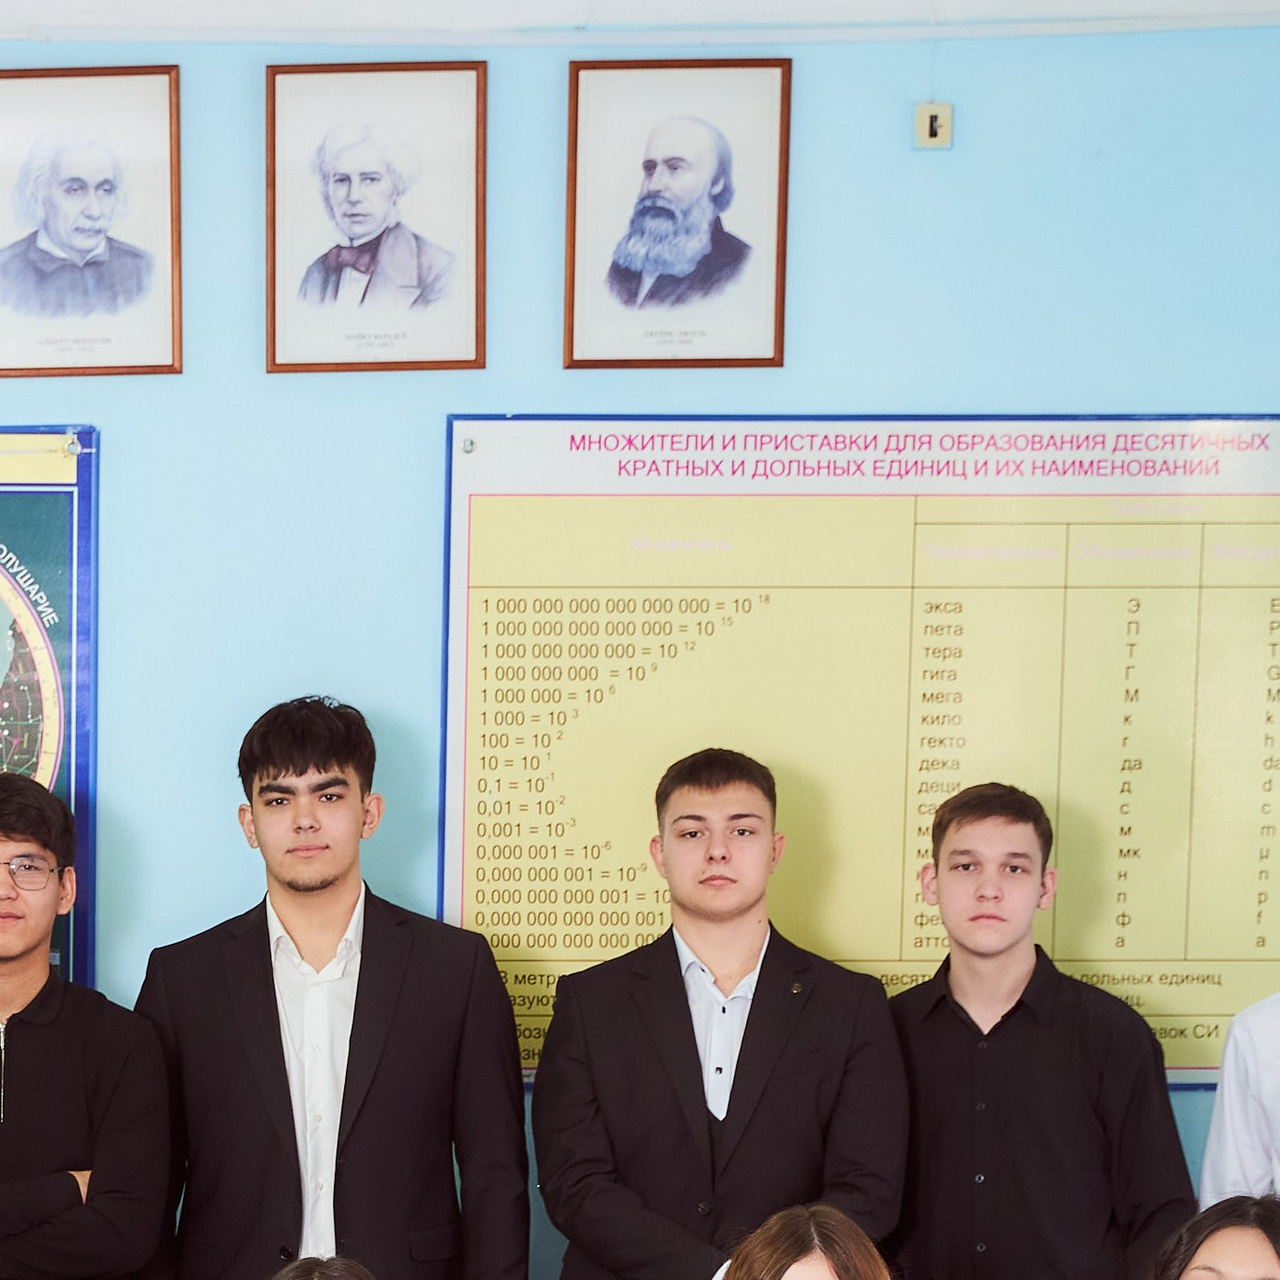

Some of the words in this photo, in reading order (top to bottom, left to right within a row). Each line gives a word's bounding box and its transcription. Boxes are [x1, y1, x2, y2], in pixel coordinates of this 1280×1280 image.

[570, 435, 714, 451] МНОЖИТЕЛИ
[722, 435, 735, 450] И
[744, 435, 877, 451] ПРИСТАВКИ
[884, 435, 932, 454] ДЛЯ
[940, 435, 1105, 451] ОБРАЗОВАНИЯ
[1112, 434, 1269, 454] ДЕСЯТИЧНЫХ
[619, 460, 723, 476] КРАТНЫХ
[732, 460, 745, 476] И
[752, 460, 864, 479] ДОЛЬНЫХ
[873, 460, 967, 480] ЕДИНИЦ
[975, 460, 987, 476] И
[996, 460, 1024, 476] ИХ
[1032, 460, 1218, 476] НАИМЕНОВАНИЙ
[483, 599, 489, 613] 1
[497, 599, 527, 613] 000
[533, 599, 563, 613] 000
[569, 599, 600, 613] 000
[606, 599, 636, 613] 000
[642, 599, 673, 613] 000
[679, 598, 709, 613] 000
[734, 599, 751, 613] 10
[924, 602, 963, 614] экса
[482, 622, 488, 636] 1
[496, 621, 526, 636] 000
[532, 621, 563, 636] 000
[569, 621, 599, 636] 000
[605, 621, 636, 636] 000
[642, 621, 672, 636] 000
[697, 622, 714, 636] 10
[924, 625, 963, 635] пета
[482, 645, 488, 658] 1
[496, 644, 526, 658] 000
[532, 644, 562, 658] 000
[568, 644, 599, 658] 000
[605, 644, 635, 658] 000
[660, 644, 677, 658] 10
[924, 647, 962, 661] тера
[482, 667, 488, 681] 1
[495, 666, 526, 681] 000
[532, 666, 562, 681] 000
[568, 666, 598, 681] 000
[629, 667, 645, 680] 10
[923, 670, 956, 680] гига
[481, 689, 487, 703] 1
[495, 689, 525, 703] 000
[532, 689, 561, 703] 000
[586, 689, 603, 703] 10
[922, 692, 962, 703] мега
[481, 712, 487, 726] 1
[495, 711, 525, 726] 000
[549, 711, 566, 725] 10
[921, 714, 961, 726] кило
[481, 734, 509, 748] 100
[533, 734, 551, 748] 10
[921, 737, 965, 748] гекто
[481, 756, 498, 770] 10
[522, 756, 539, 770] 10
[919, 760, 959, 771] дека
[478, 778, 500, 793] 0,1
[478, 801, 510, 816] 0,01
[477, 823, 520, 838] 0,001
[477, 845, 522, 860] 0,000
[529, 845, 556, 859] 001
[476, 867, 522, 883] 0,000
[528, 867, 558, 882] 000
[564, 867, 592, 881] 001
[476, 889, 521, 905] 0,000
[528, 889, 558, 904] 000
[564, 889, 594, 904] 000
[600, 889, 627, 904] 001
[475, 911, 521, 928] 0,000
[527, 911, 557, 926] 000
[563, 911, 593, 926] 000
[600, 911, 630, 926] 000
[636, 912, 663, 926] 001
[527, 934, 557, 948] 000
[563, 934, 593, 948] 000
[599, 934, 629, 948] 000
[1160, 974, 1223, 986] единиц
[1193, 1024, 1220, 1039] СИ
